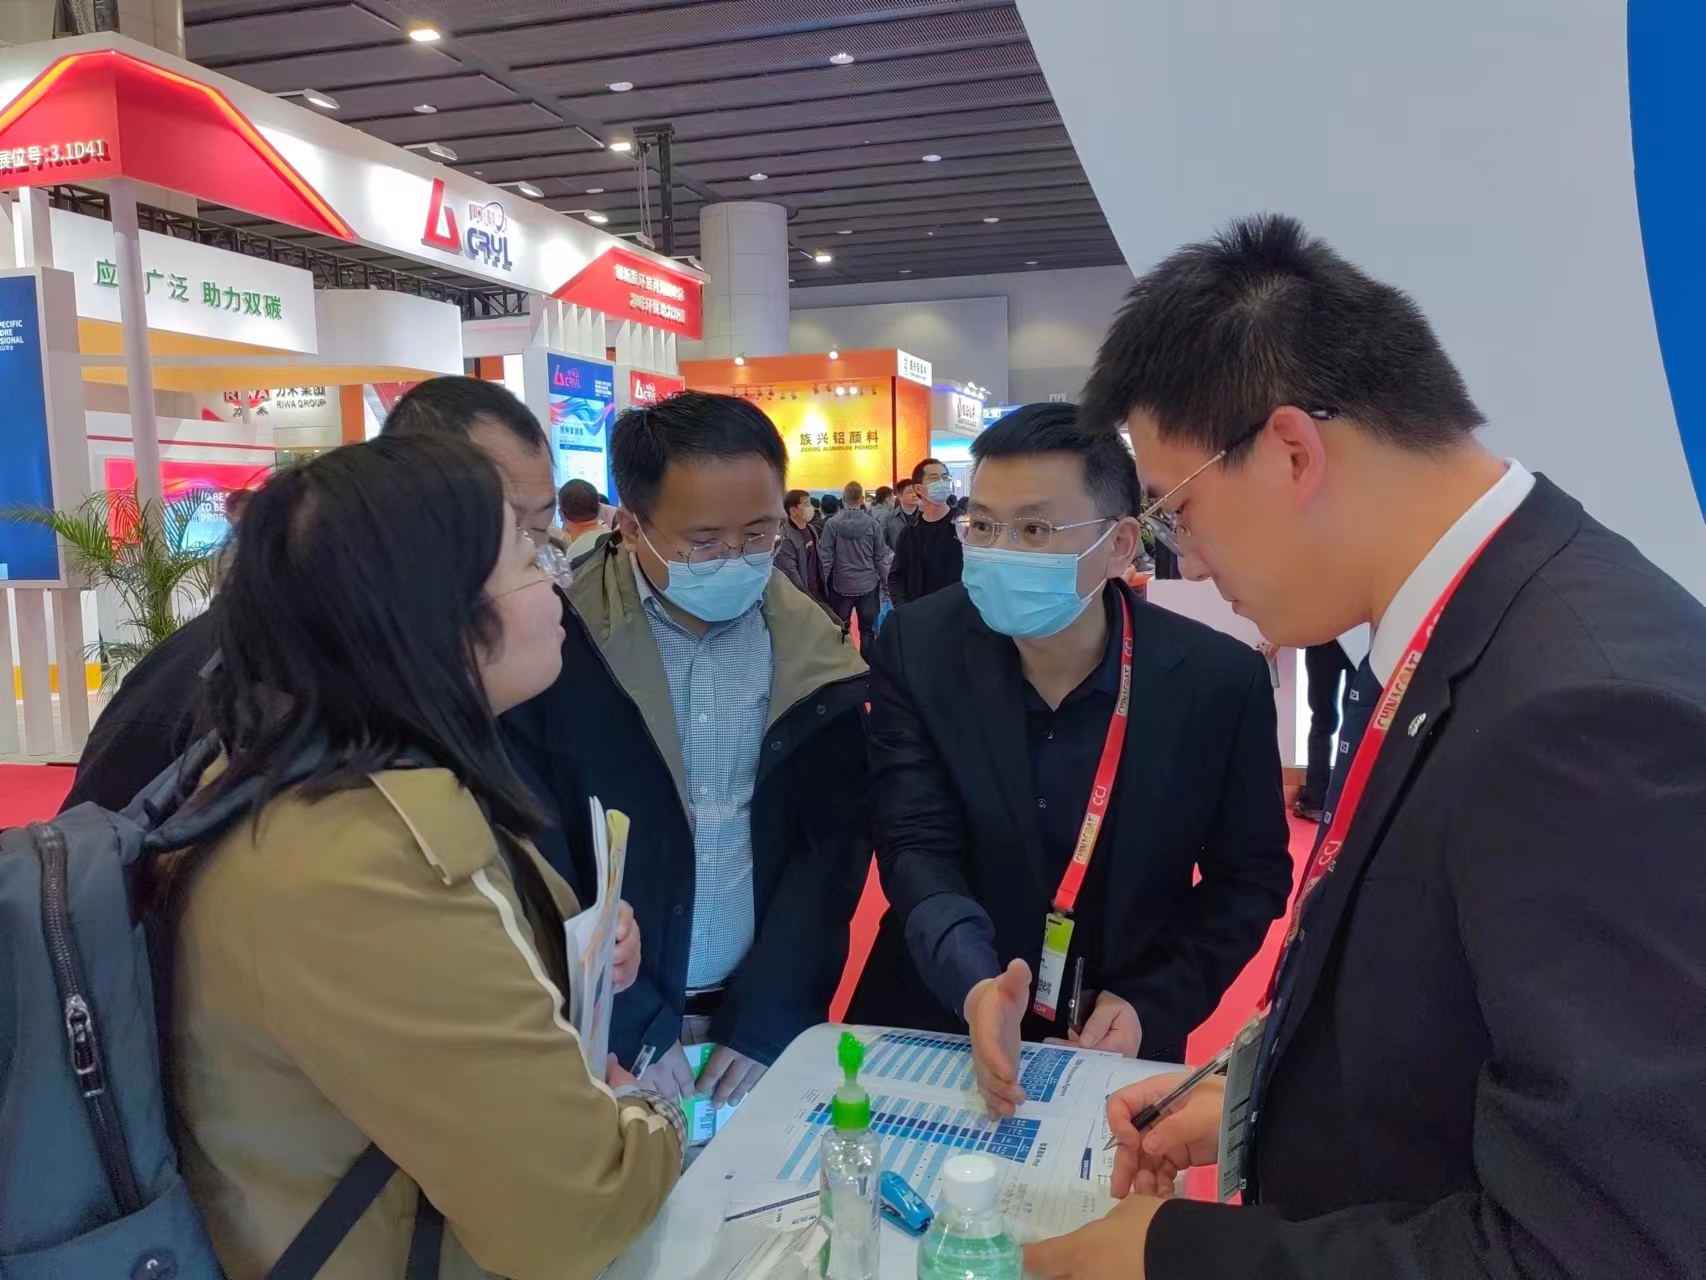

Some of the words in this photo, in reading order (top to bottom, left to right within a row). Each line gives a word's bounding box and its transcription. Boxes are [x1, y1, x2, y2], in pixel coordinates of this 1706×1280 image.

[96, 259, 189, 302] 应广泛
[203, 281, 283, 319] 助力双碳
[800, 430, 879, 446] 族兴铝颜料
